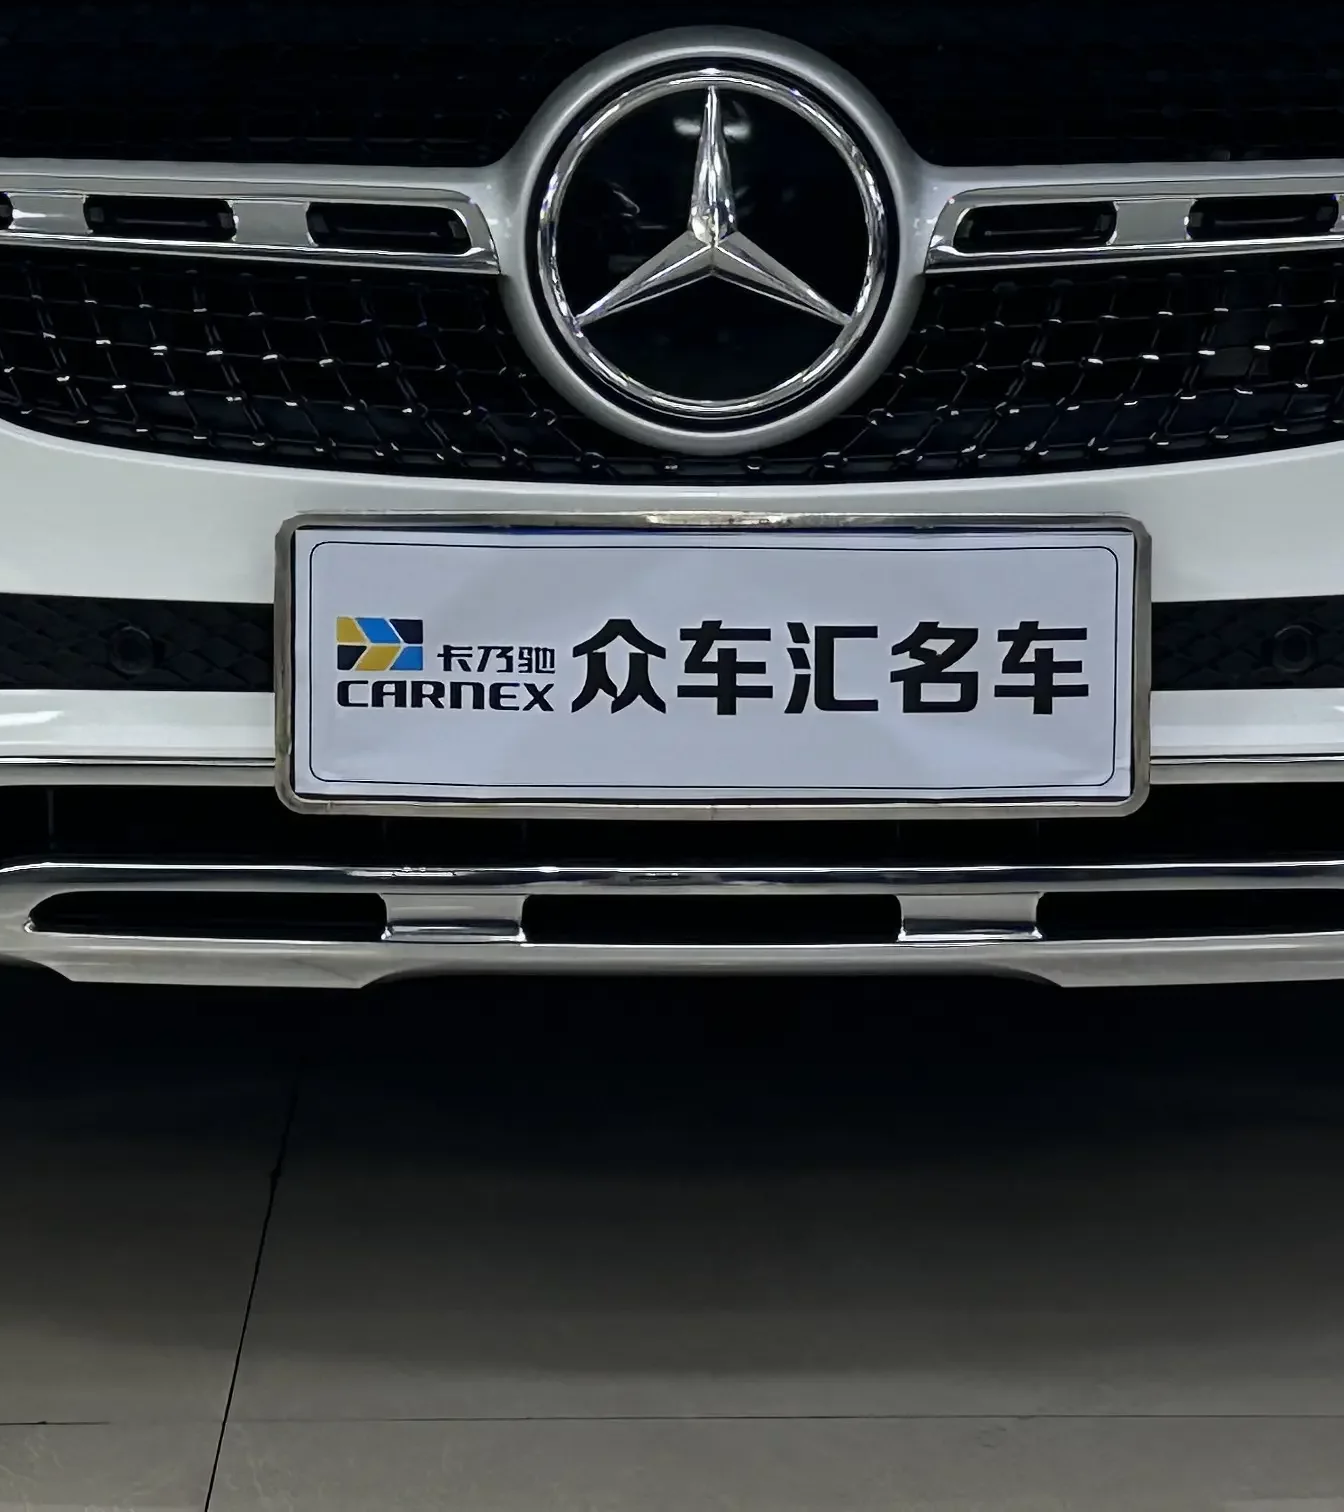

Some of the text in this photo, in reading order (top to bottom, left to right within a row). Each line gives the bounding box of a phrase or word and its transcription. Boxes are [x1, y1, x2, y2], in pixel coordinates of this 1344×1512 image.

[436, 644, 556, 674] 卡乃驰
[570, 618, 1089, 716] 众车汇名车
[336, 679, 555, 712] CARNEX
